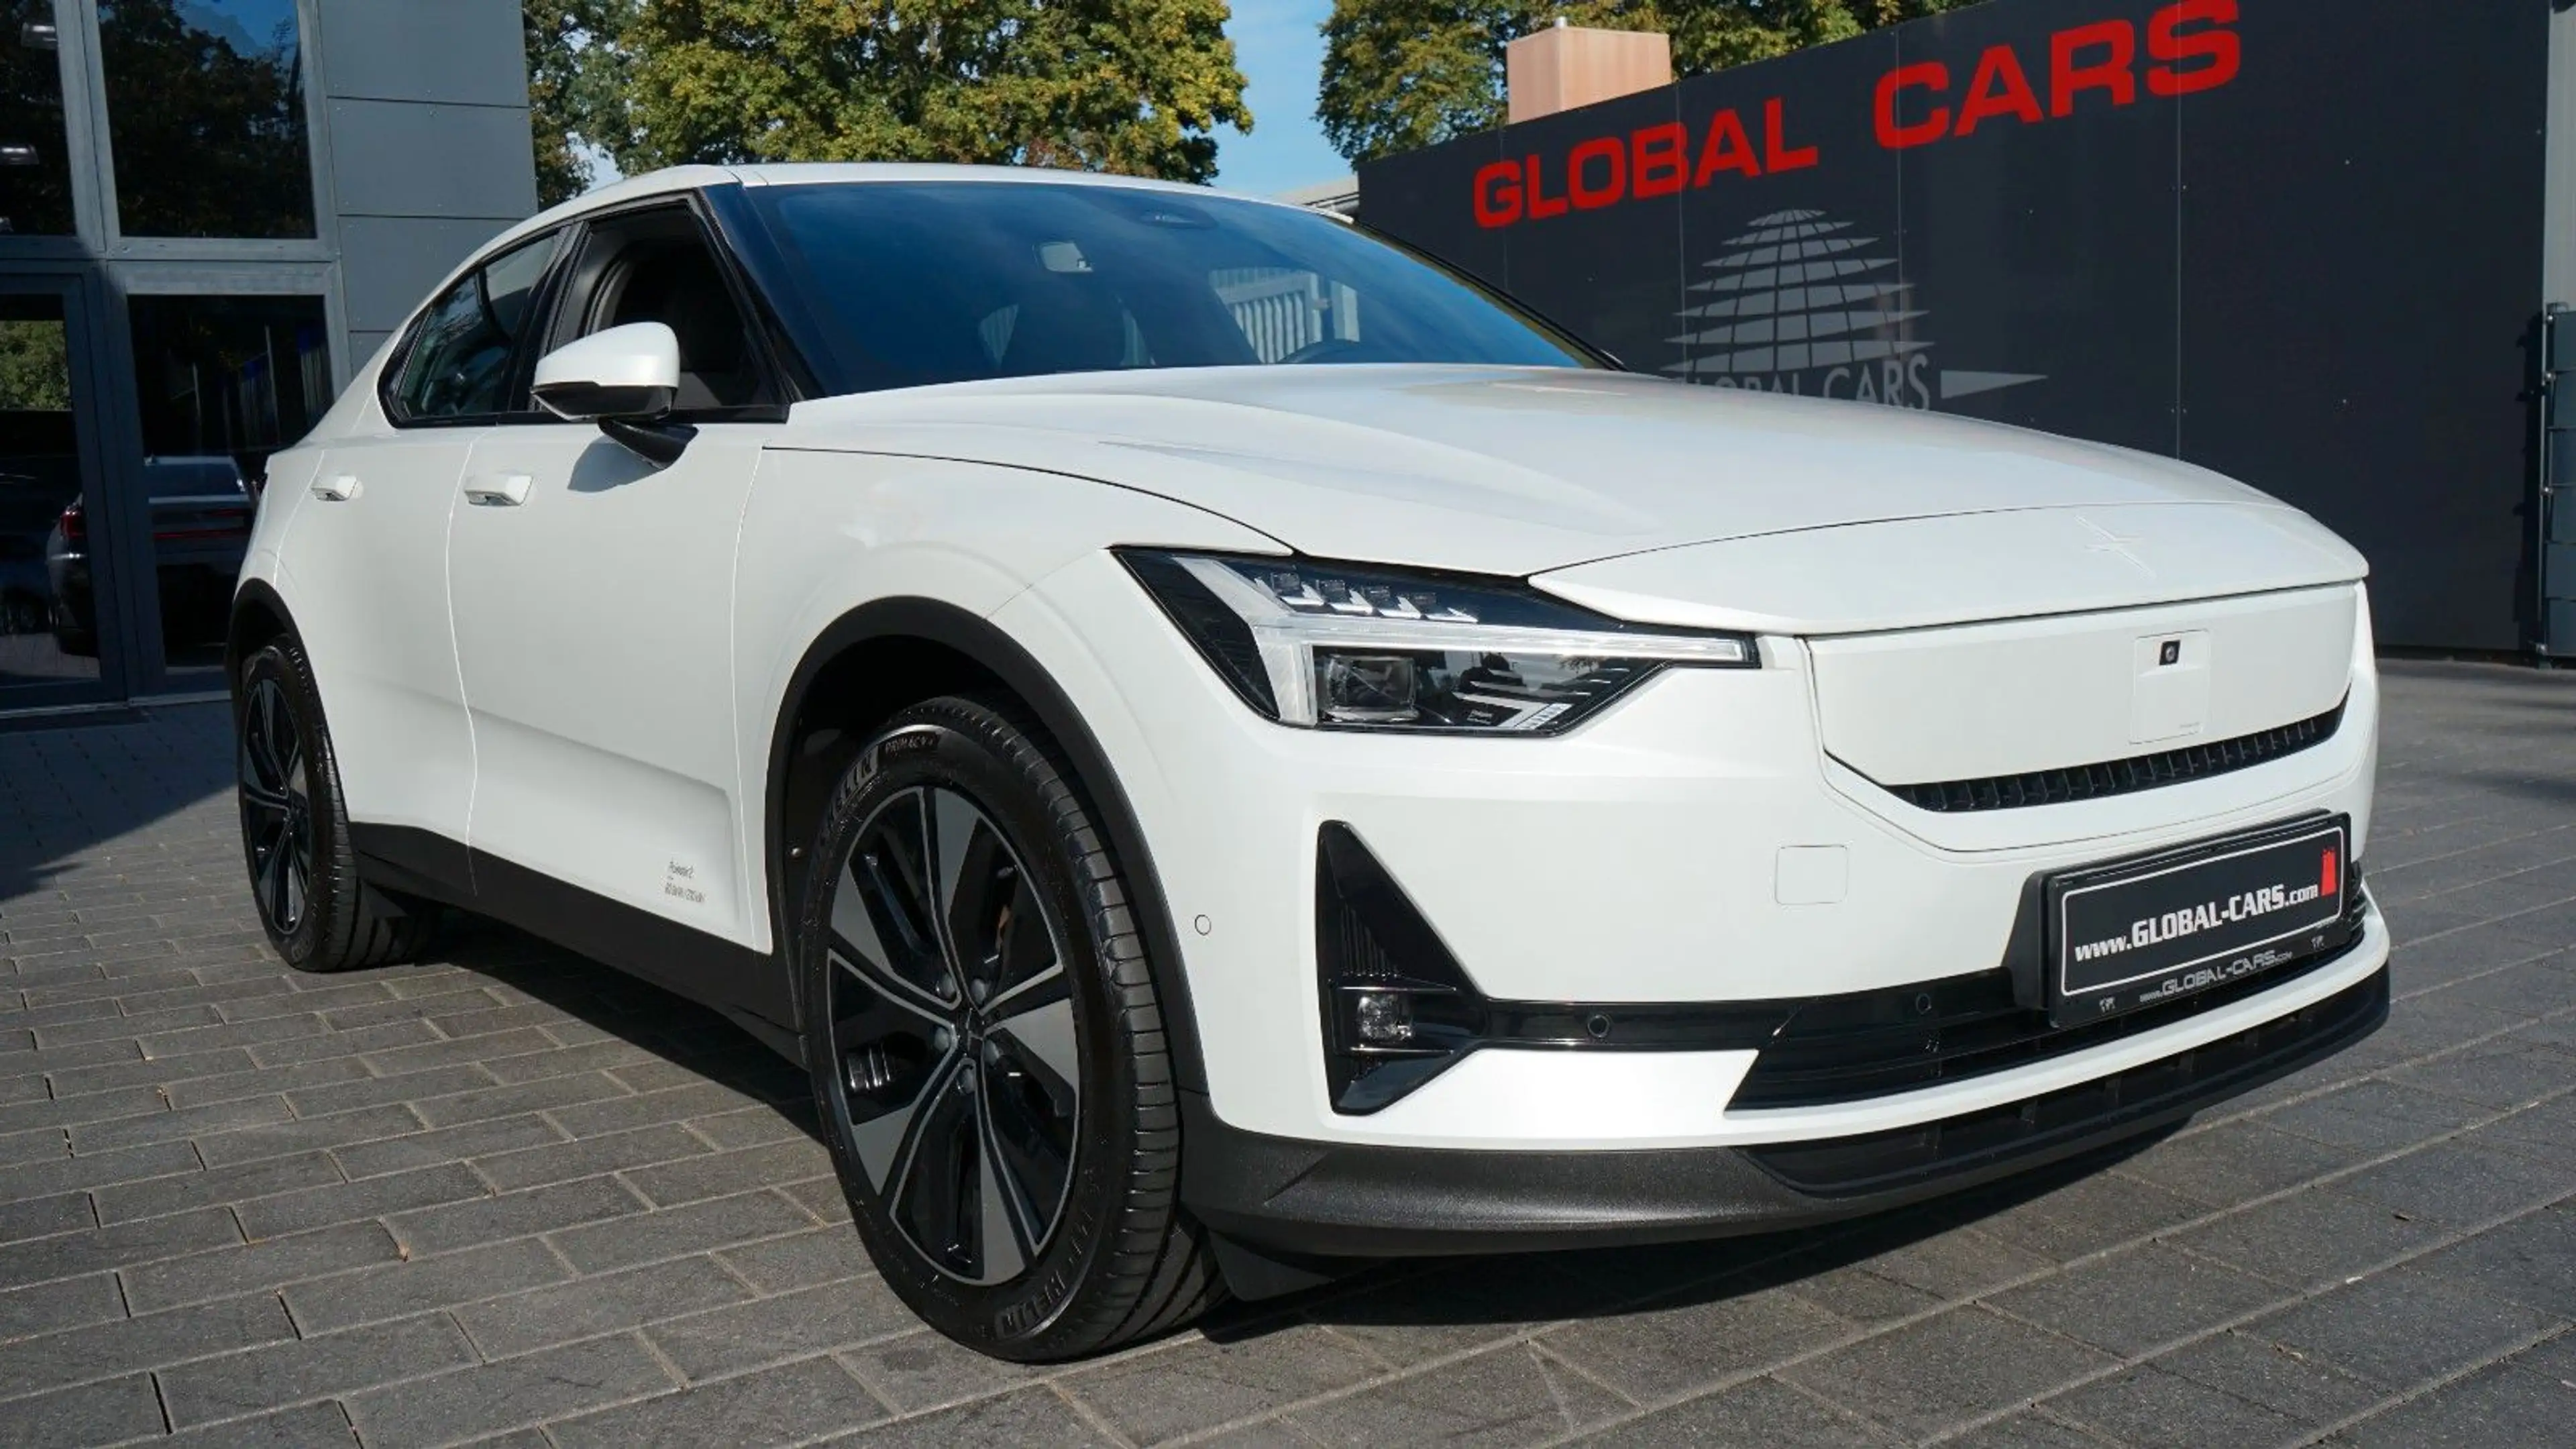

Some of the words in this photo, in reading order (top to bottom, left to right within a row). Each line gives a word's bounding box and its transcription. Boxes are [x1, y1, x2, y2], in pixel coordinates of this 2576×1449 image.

[1473, 97, 1817, 228] GLOBAL
[1873, 0, 2241, 149] CARS
[1824, 353, 1930, 411] CARS
[2074, 883, 2319, 962] www.GLOBAL-CARS.com
